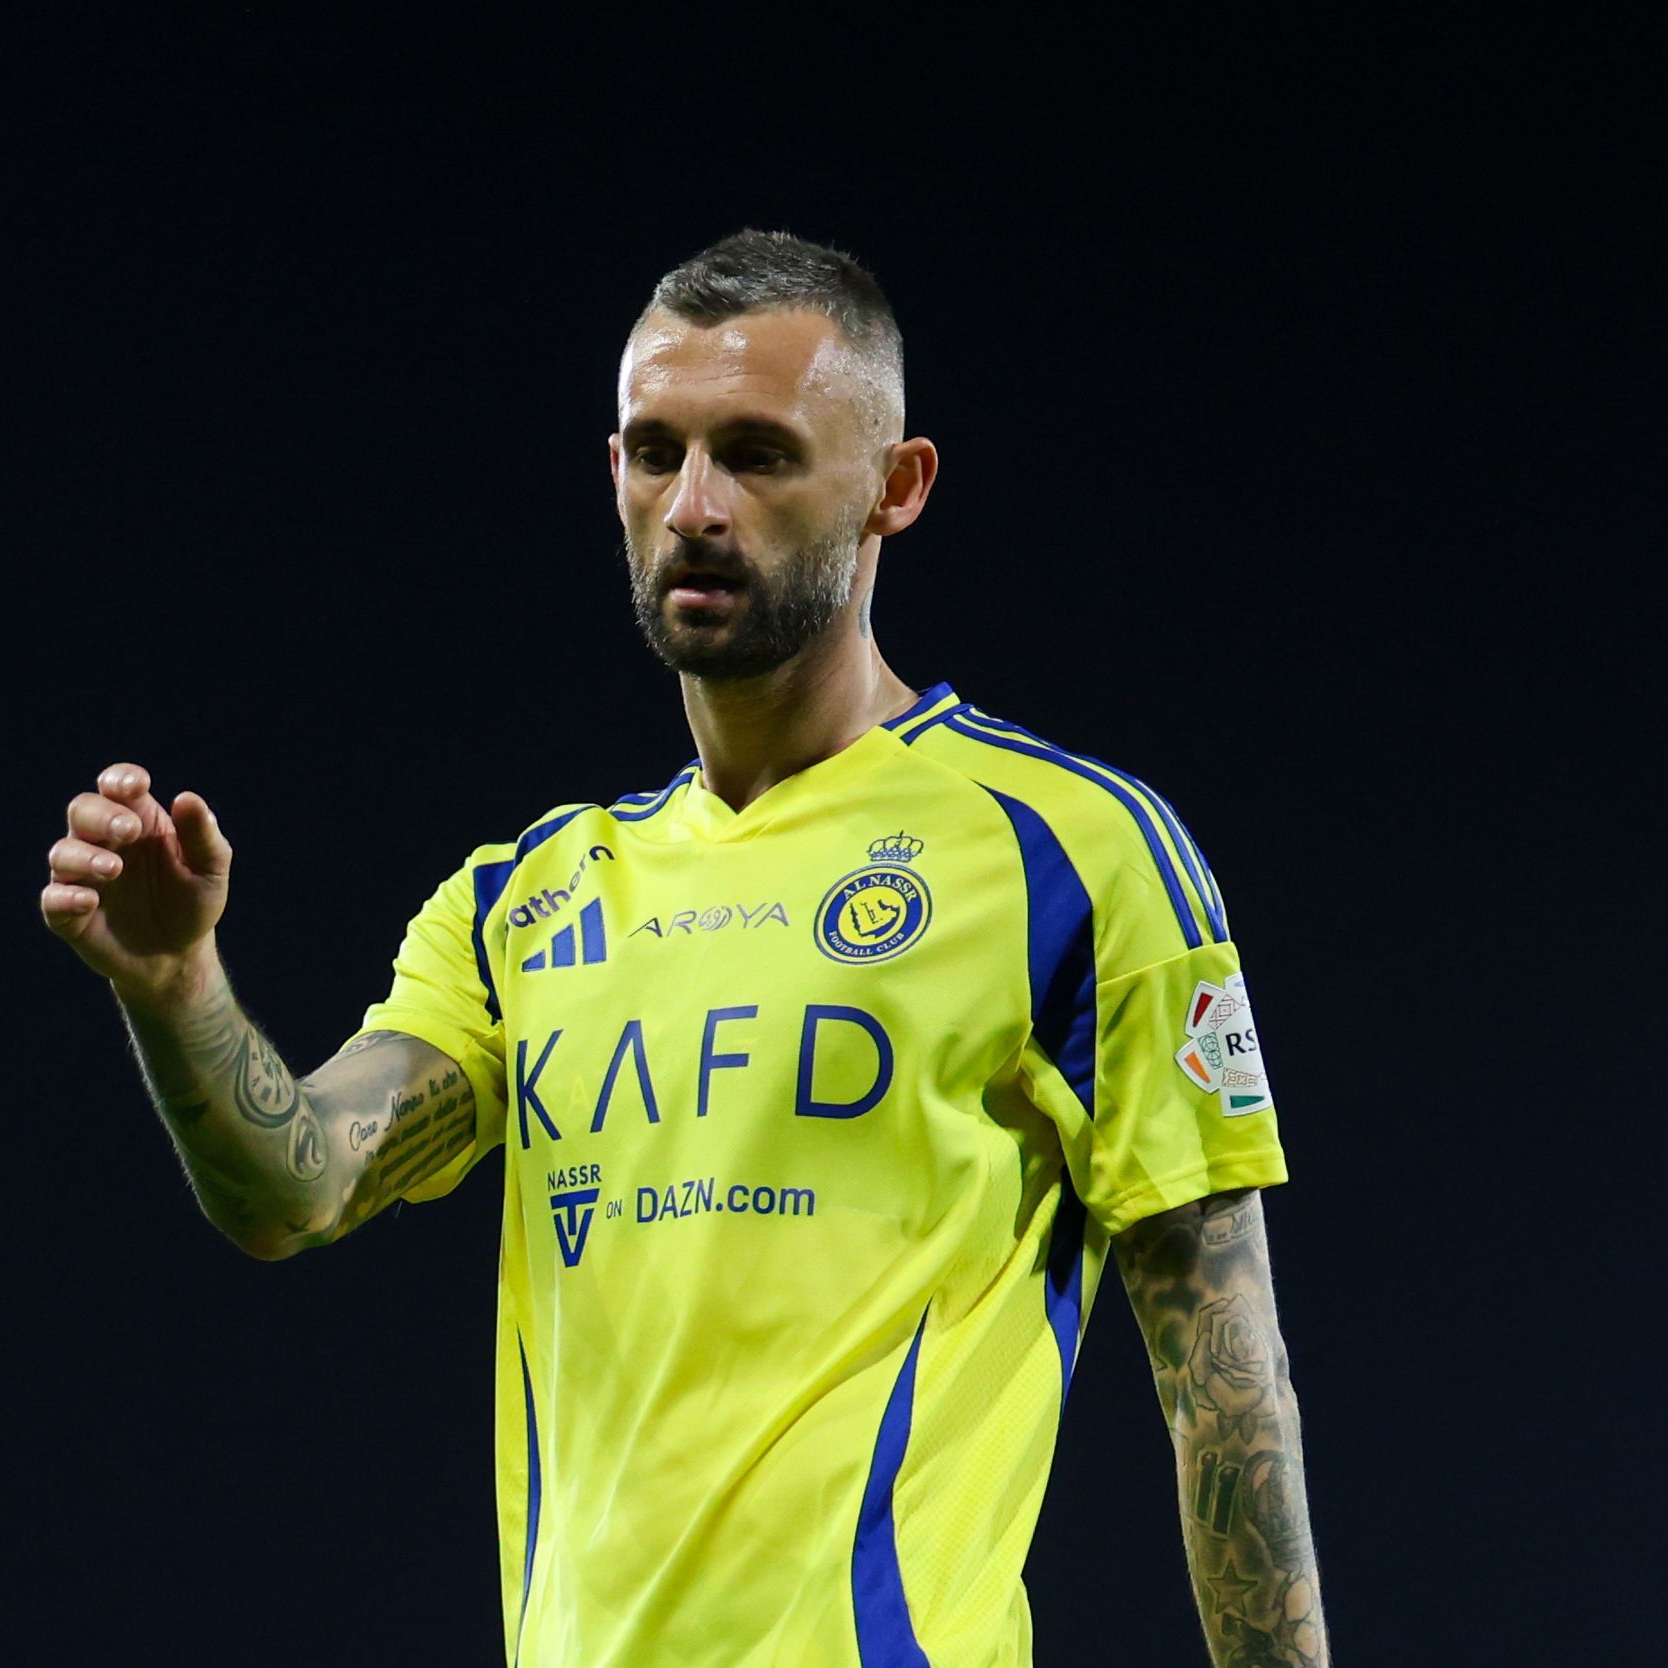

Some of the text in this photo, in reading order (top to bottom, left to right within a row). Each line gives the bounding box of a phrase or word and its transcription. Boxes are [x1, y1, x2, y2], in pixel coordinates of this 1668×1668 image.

[505, 846, 615, 932] athern
[843, 875, 917, 902] AL NASSR
[829, 930, 904, 956] FOOTBALL CLUB
[516, 1004, 894, 1149] KAFD
[547, 1164, 602, 1191] NASSR
[550, 1177, 815, 1268] TV ON DAZN.com
